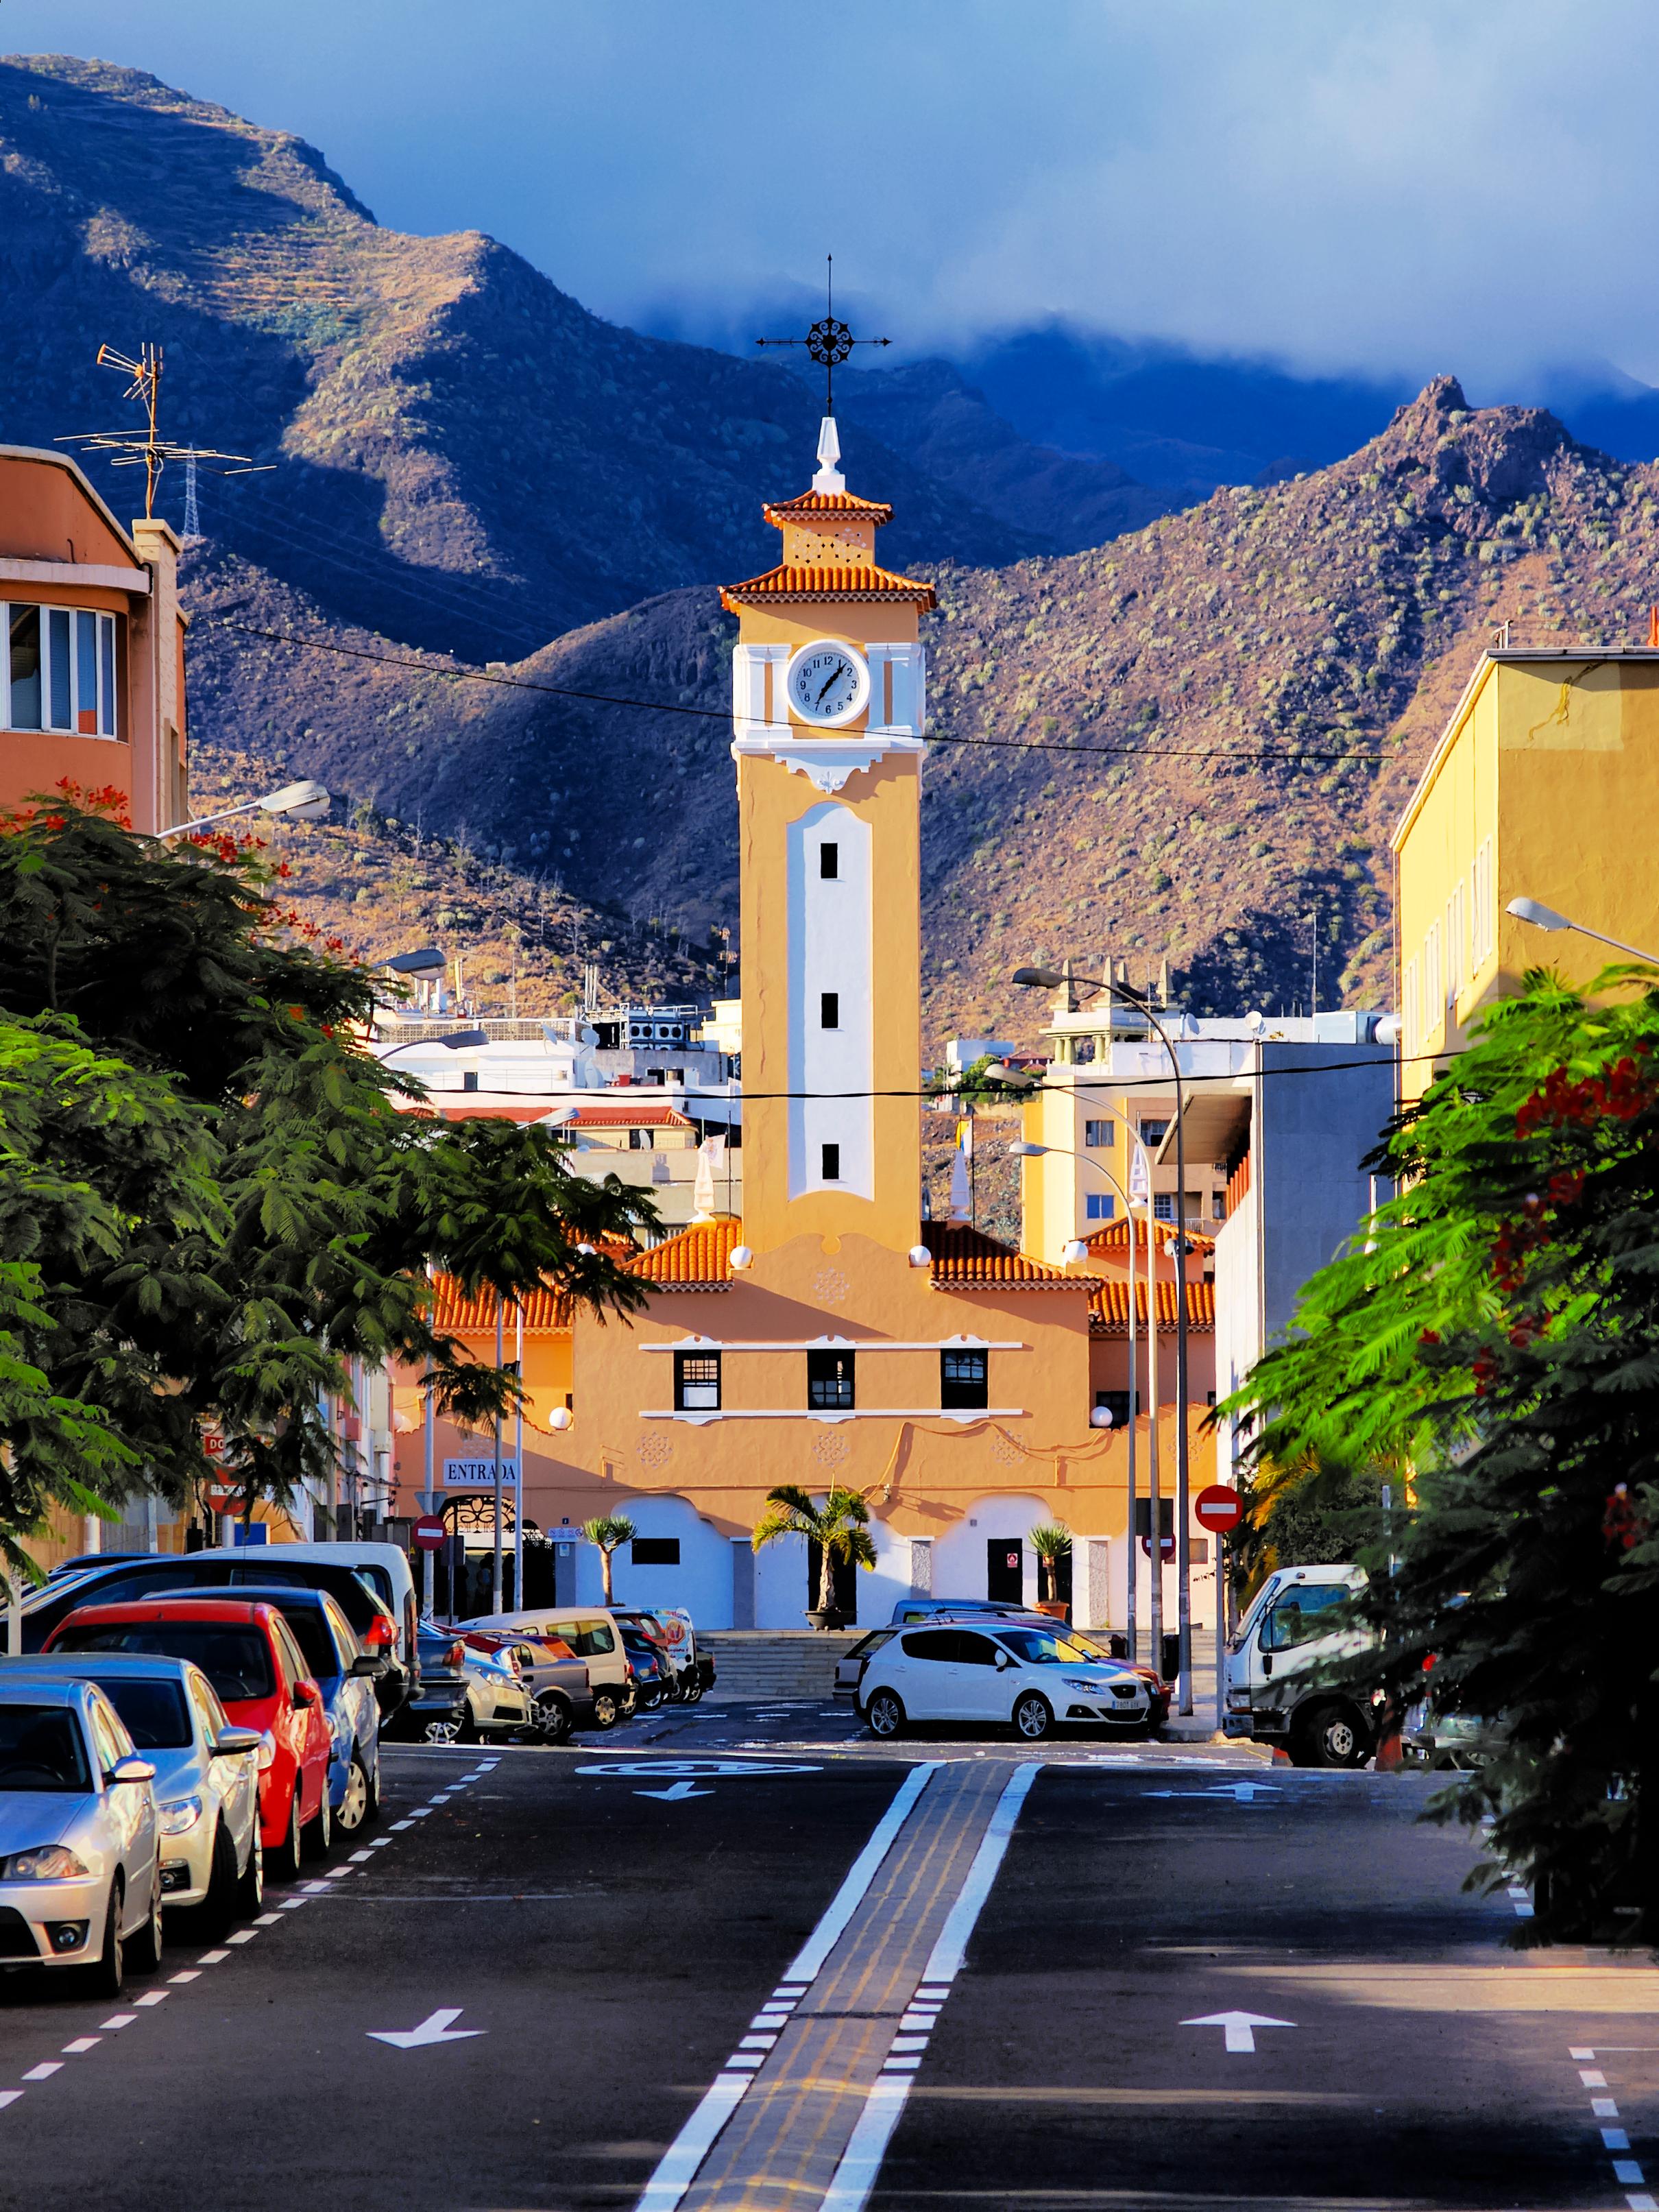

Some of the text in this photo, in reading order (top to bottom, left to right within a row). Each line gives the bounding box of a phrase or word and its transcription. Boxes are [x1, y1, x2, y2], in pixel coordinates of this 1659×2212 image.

[813, 660, 820, 669] 11
[824, 656, 833, 665] 12
[803, 668, 812, 677] 10
[847, 668, 853, 677] 2
[800, 680, 806, 690] 9
[851, 680, 857, 689] 3
[804, 693, 810, 702] 8
[847, 693, 852, 701] 4
[814, 701, 819, 711] 7
[825, 705, 831, 714] 6
[838, 701, 843, 710] 5
